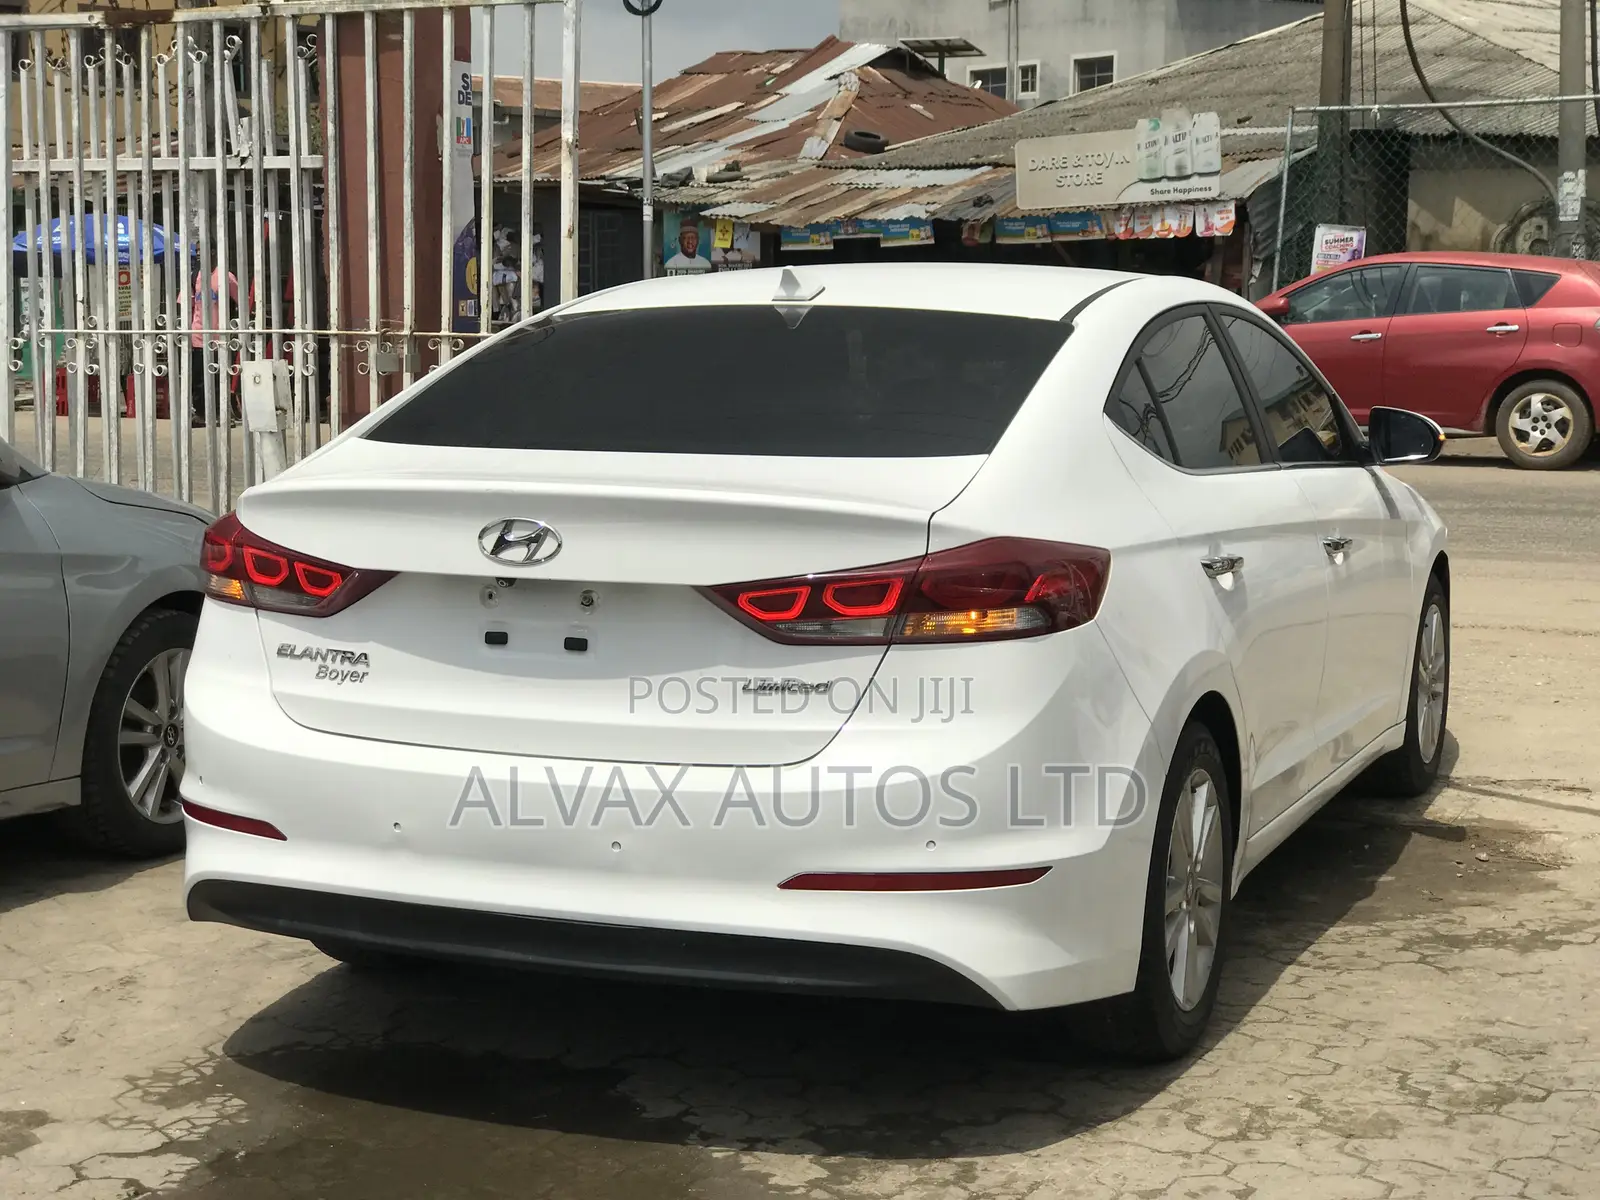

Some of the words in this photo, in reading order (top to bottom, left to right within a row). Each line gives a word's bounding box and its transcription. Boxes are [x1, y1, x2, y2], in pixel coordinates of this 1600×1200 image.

[1028, 156, 1068, 171] DARE
[1072, 155, 1083, 168] &
[1056, 172, 1103, 188] STORE
[1150, 187, 1171, 196] Share
[1172, 185, 1212, 195] Happiness
[1325, 236, 1354, 245] SUMMER
[276, 642, 371, 669] ELANTRA
[315, 663, 370, 686] Boyer
[741, 678, 834, 696] Limited
